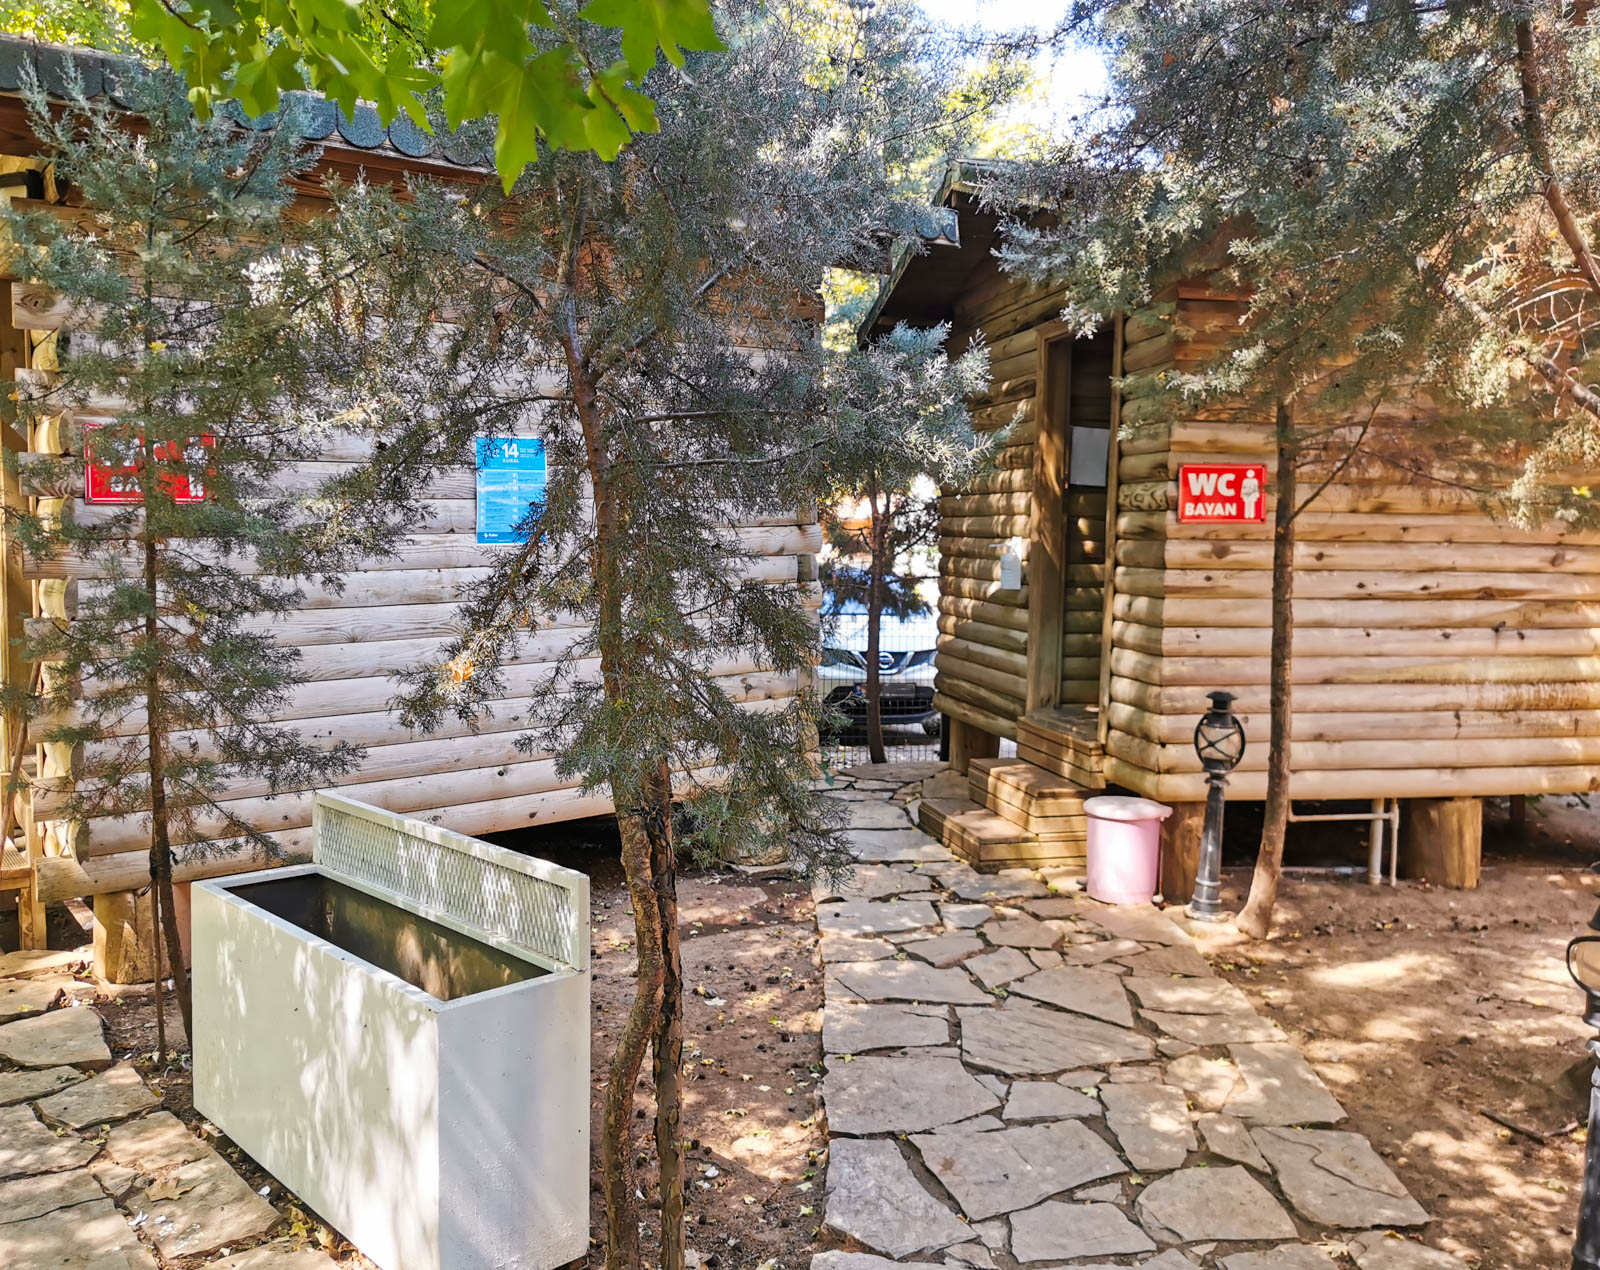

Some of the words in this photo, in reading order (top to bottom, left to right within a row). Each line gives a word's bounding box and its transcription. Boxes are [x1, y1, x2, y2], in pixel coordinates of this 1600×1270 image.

[501, 443, 519, 458] 14
[1187, 473, 1236, 496] WC
[1185, 502, 1237, 516] BAYAN
